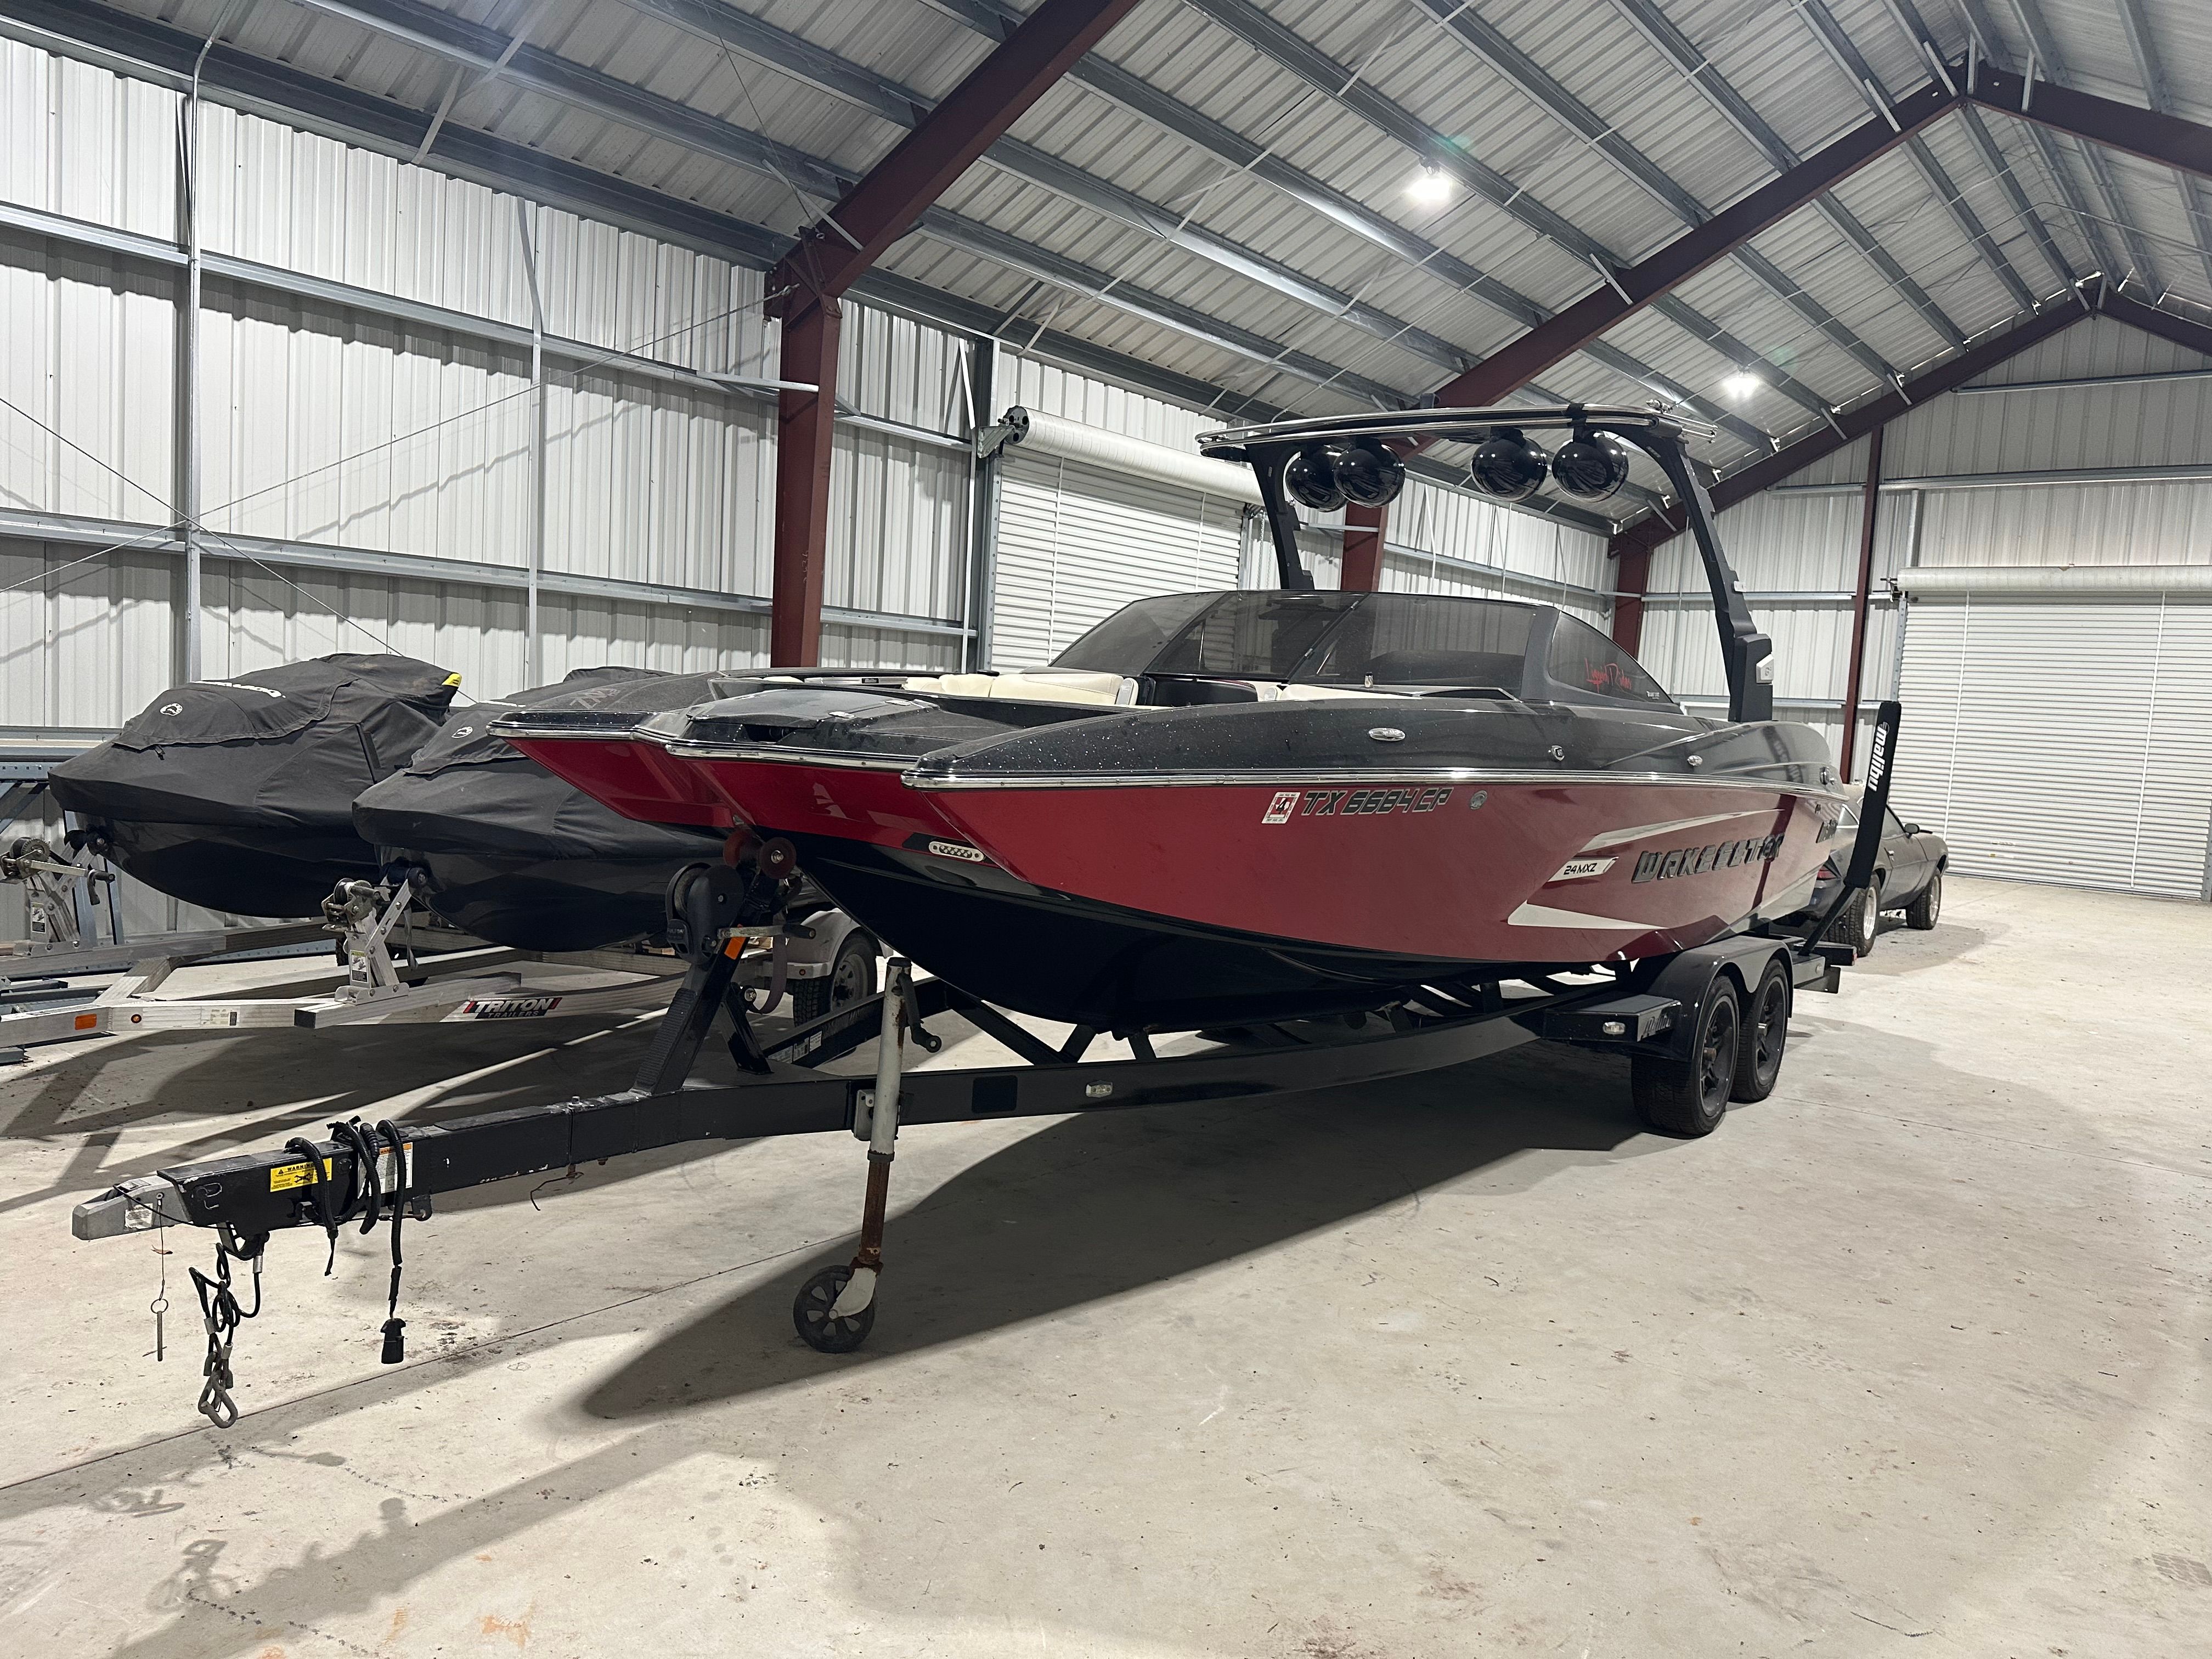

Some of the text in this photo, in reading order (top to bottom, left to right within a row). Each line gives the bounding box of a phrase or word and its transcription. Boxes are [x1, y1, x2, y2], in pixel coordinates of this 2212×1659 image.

[1867, 725, 1887, 792] malibu
[1276, 798, 1288, 815] 4
[1301, 791, 1348, 815] TX
[1340, 788, 1420, 815] 6684
[475, 998, 554, 1013] TRITON
